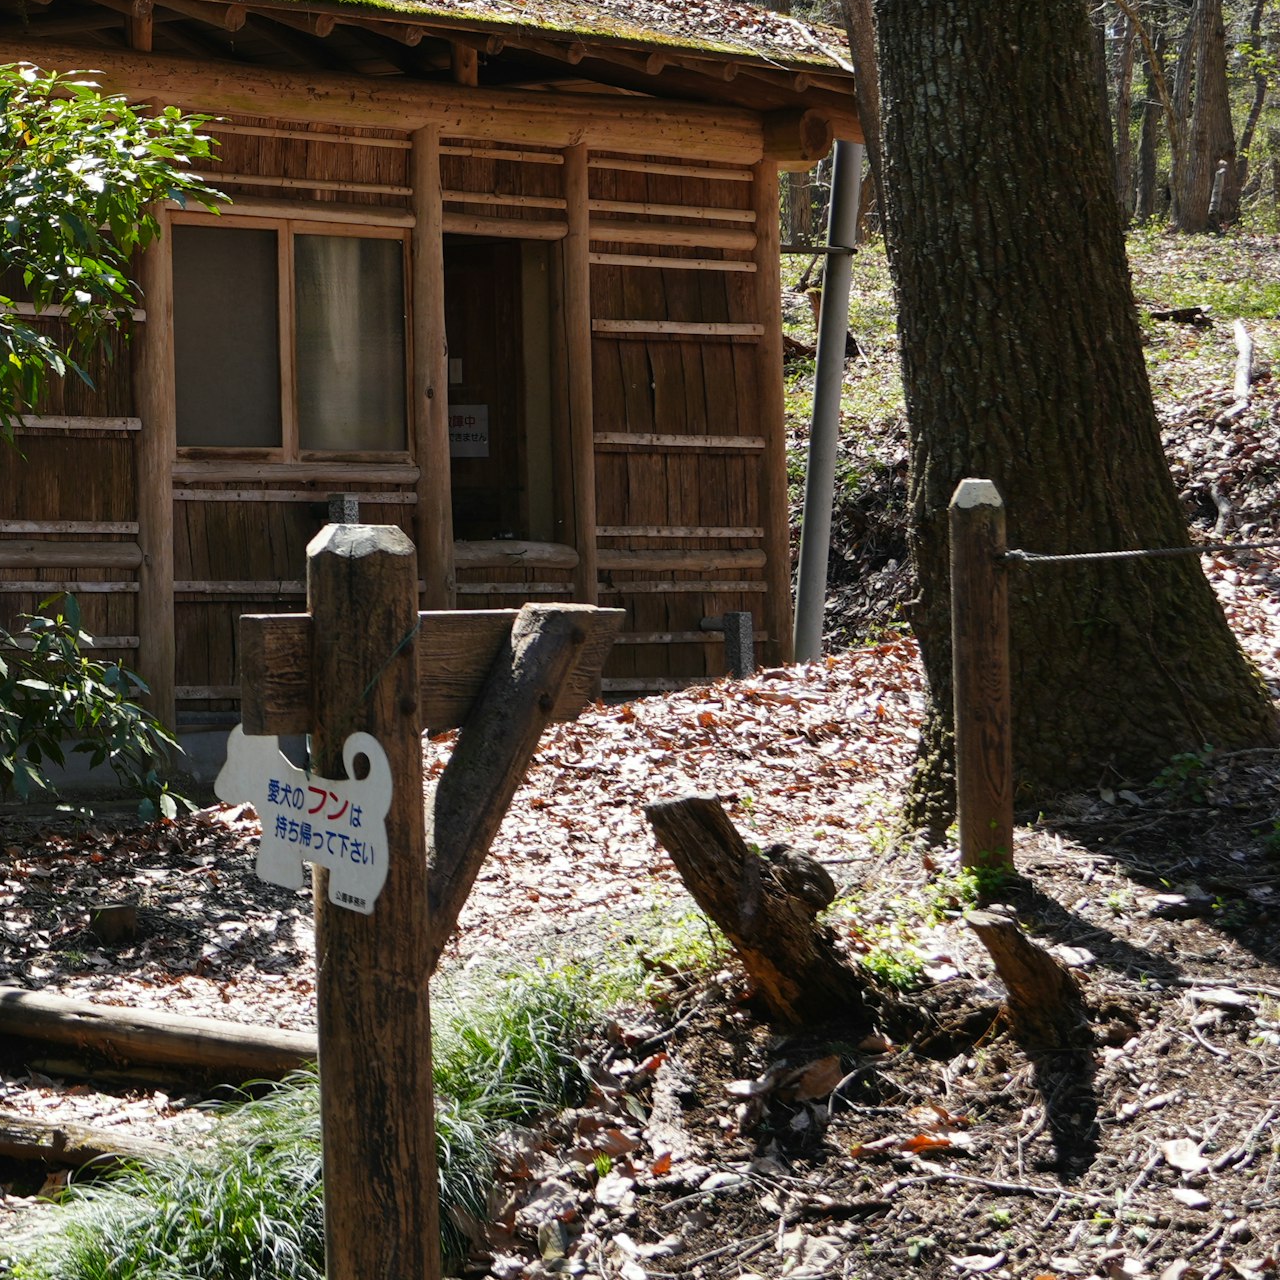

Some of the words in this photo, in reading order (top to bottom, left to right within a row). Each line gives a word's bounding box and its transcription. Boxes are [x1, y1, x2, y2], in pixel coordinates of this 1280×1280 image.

[274, 813, 375, 865] 持ち帰って下さい
